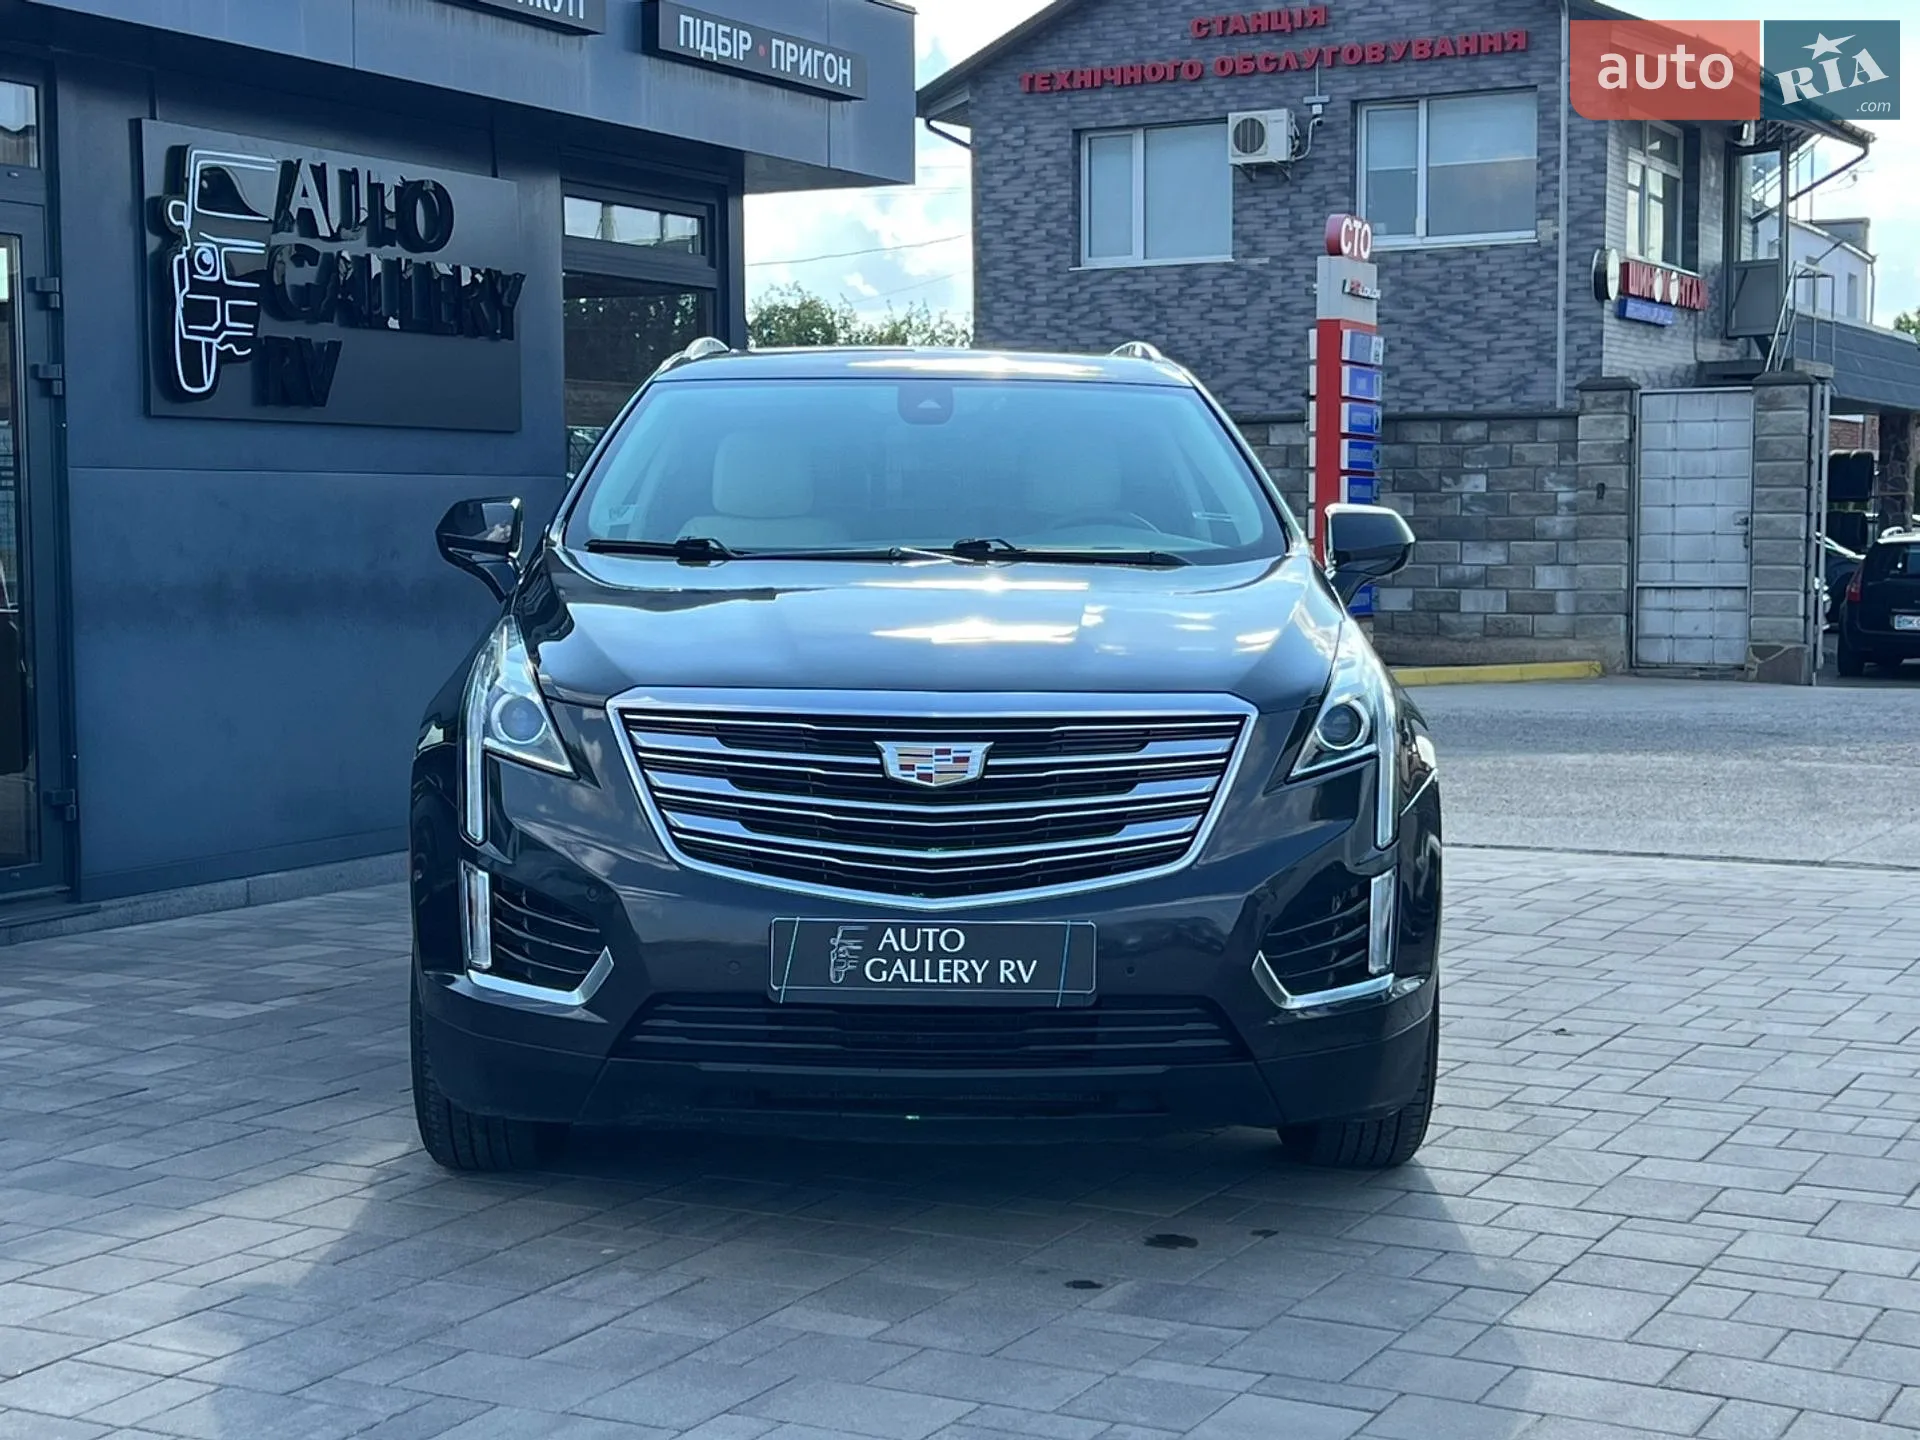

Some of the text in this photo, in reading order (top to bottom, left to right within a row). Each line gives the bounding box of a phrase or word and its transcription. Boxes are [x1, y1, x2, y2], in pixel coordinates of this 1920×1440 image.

[679, 14, 851, 88] ПІДБІР ПРИГОН
[1190, 5, 1328, 39] СТАНЦІЯ
[1019, 29, 1528, 93] ТЕХНІЧНОГО ОБСЛУГОВУВАННЯ
[274, 157, 455, 253] AUTO
[266, 243, 527, 342] GALLERY
[254, 335, 343, 408] RV
[864, 957, 1038, 984] GALLERY RV
[878, 927, 966, 953] AUTO
